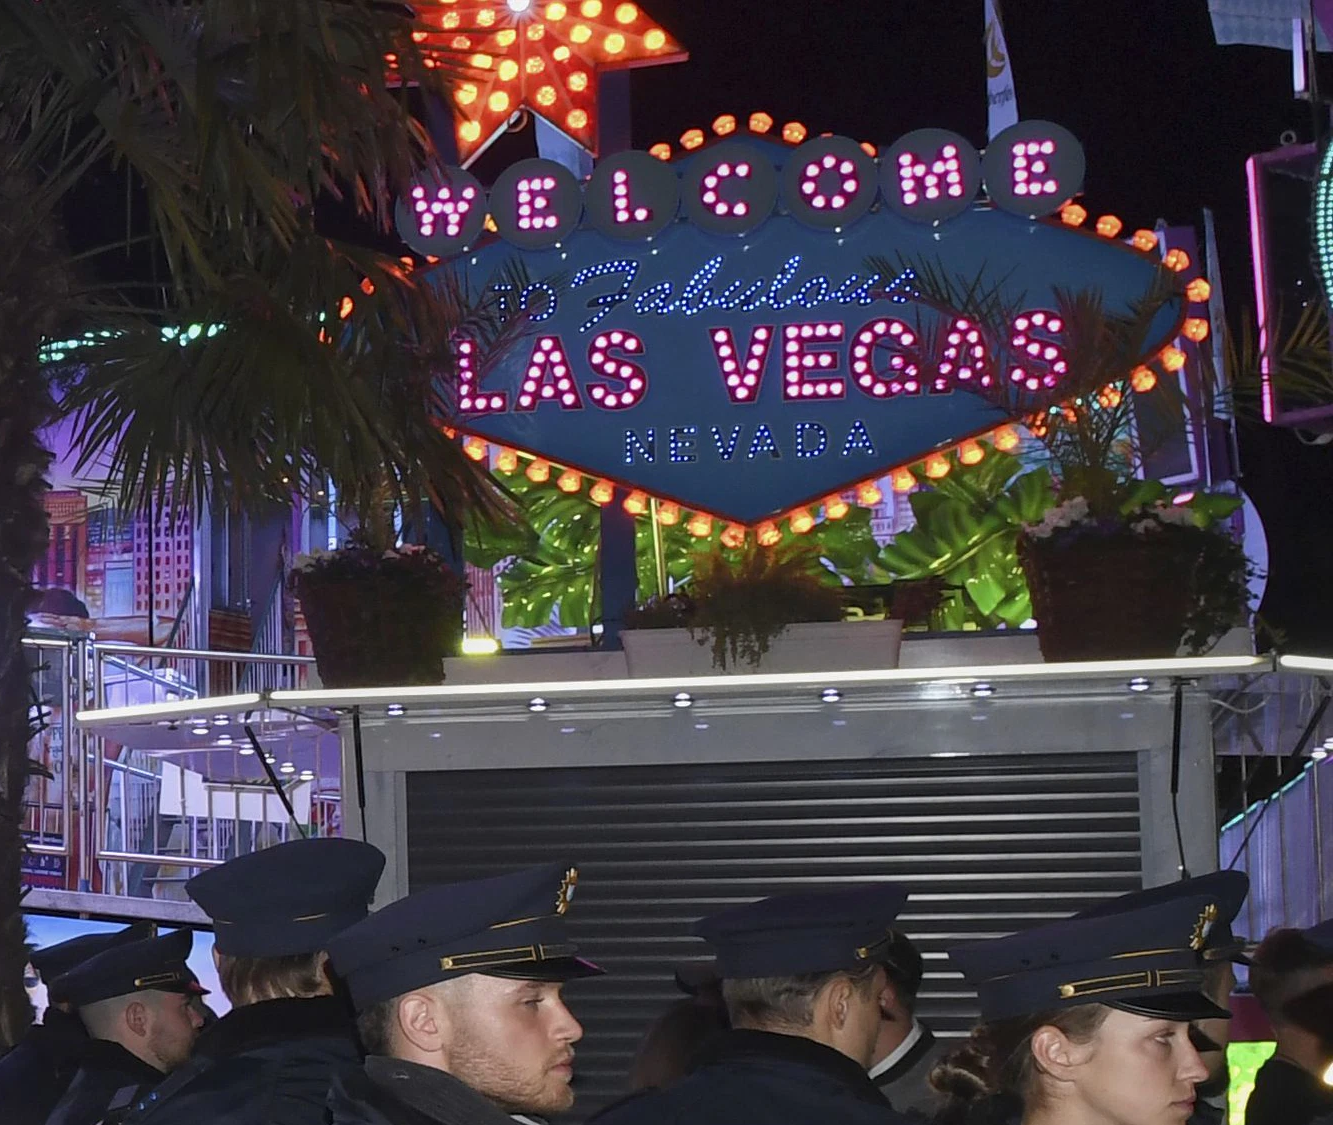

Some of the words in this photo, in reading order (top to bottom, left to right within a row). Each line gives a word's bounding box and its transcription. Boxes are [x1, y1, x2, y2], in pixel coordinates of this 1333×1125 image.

[409, 136, 1060, 239] WELCOME
[488, 281, 558, 324] TO
[570, 253, 921, 332] Fabulous
[452, 328, 646, 414] LAS
[709, 309, 1068, 403] VEGAS
[624, 419, 879, 465] NEVADA
